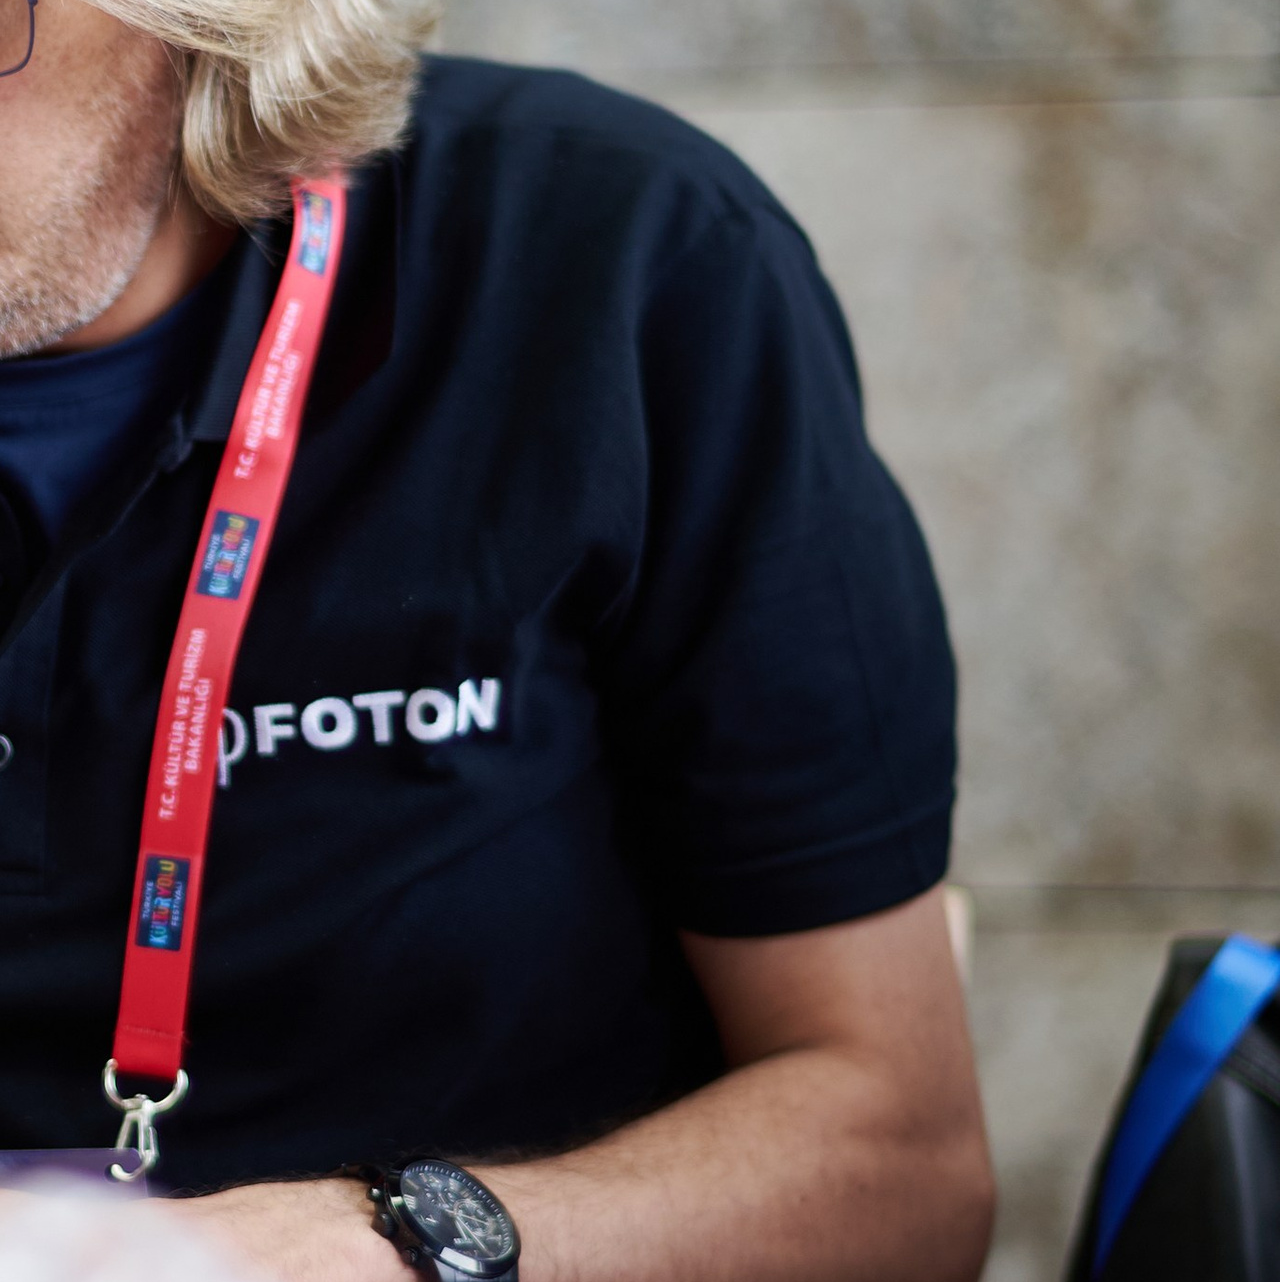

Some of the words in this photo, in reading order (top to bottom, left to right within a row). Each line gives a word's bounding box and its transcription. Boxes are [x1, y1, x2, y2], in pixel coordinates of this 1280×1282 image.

[262, 364, 278, 382] VE
[244, 388, 270, 448] KÜLTÜR
[235, 453, 255, 477] T.C.
[178, 629, 205, 690] TURİZM
[176, 696, 189, 716] VE
[184, 678, 210, 770] BAKANLIĞI
[164, 722, 185, 784] KÜLTÜR
[160, 791, 176, 818] T.C.
[143, 881, 153, 918] TÜRKİYE
